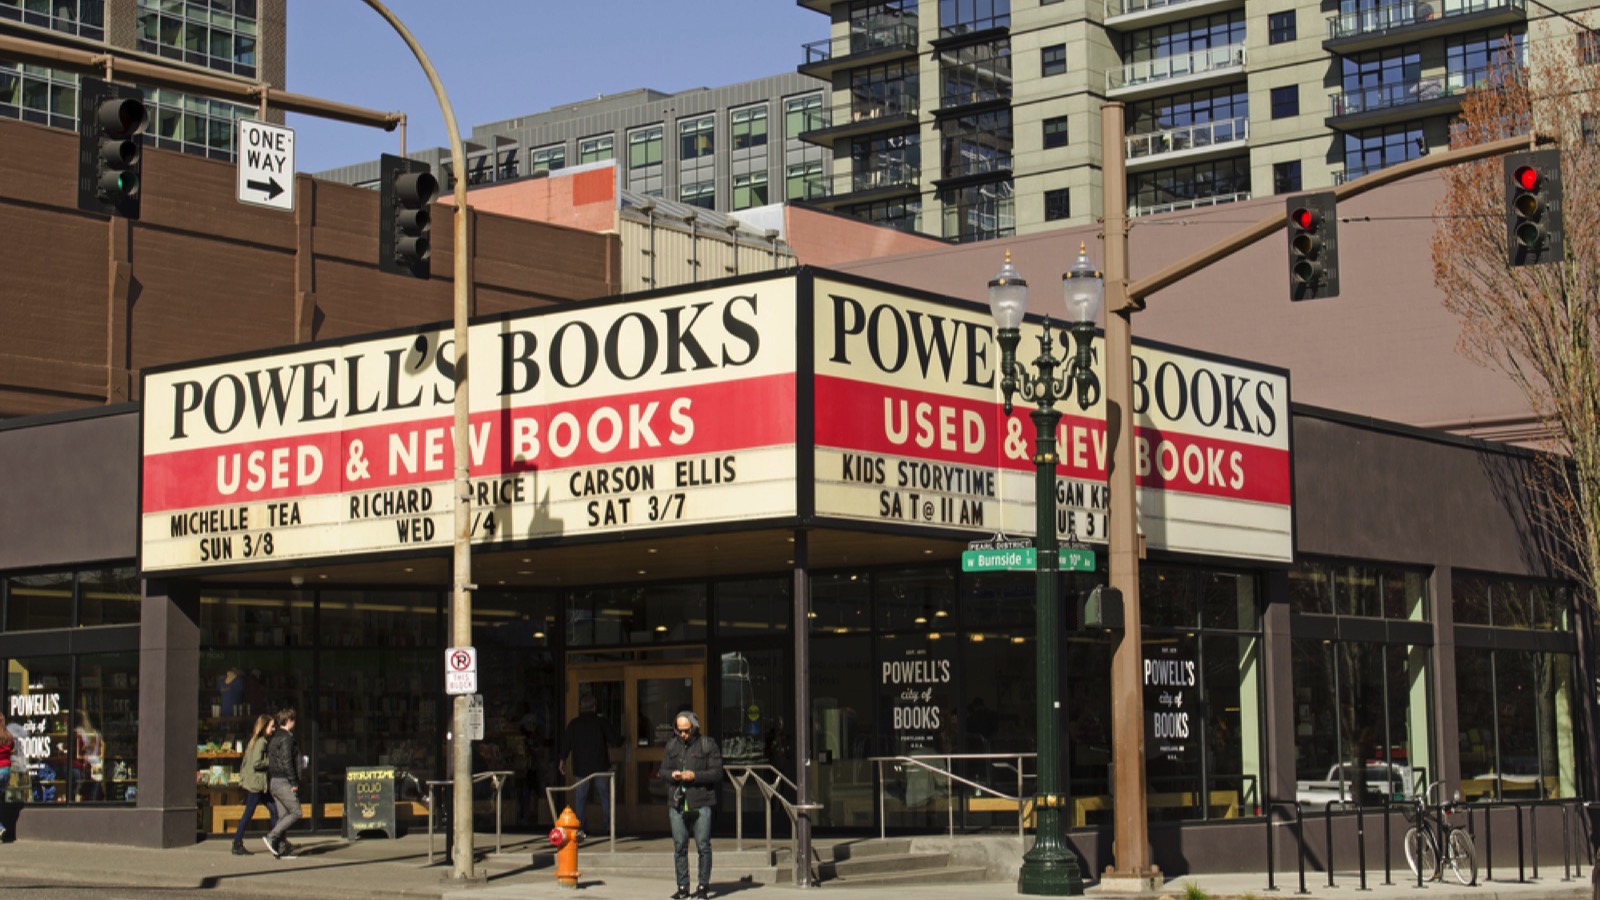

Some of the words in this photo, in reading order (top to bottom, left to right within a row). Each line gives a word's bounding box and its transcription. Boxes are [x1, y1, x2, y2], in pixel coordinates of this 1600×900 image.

[249, 128, 285, 152] ONE
[247, 149, 287, 174] WAY
[170, 334, 457, 440] POWELL'S
[496, 294, 760, 396] BOOKS
[828, 294, 1101, 408] POWE'
[1131, 355, 1276, 437] BOOKS
[216, 444, 324, 496] USED
[345, 438, 371, 482] &
[388, 421, 492, 478] NEW
[513, 397, 695, 462] BOOKS
[884, 397, 986, 455] USED
[1004, 416, 1029, 460] &
[1134, 436, 1245, 491] BOOKS
[569, 464, 655, 499] CARSON
[676, 455, 737, 488] ELLIS
[842, 453, 886, 484] KIDS
[898, 460, 995, 497] STORYTIME
[350, 487, 433, 519] RICHARD
[588, 498, 631, 527] SAT
[648, 493, 687, 521] 3/7
[170, 506, 249, 538] MICHELLE
[266, 501, 302, 528] TEA
[396, 517, 435, 543] WED
[470, 509, 497, 537] /4
[1057, 509, 1076, 534] UE
[200, 533, 232, 561] SUN
[242, 532, 274, 557] 3/8
[978, 552, 1022, 567] Burnside
[882, 659, 950, 684] POWELL'S
[1144, 659, 1195, 686] POWELL'S
[10, 693, 60, 716] POWELL'S
[900, 688, 919, 702] city
[921, 686, 932, 702] of
[893, 706, 940, 729] BOOKS
[1154, 712, 1189, 738] BOOKS
